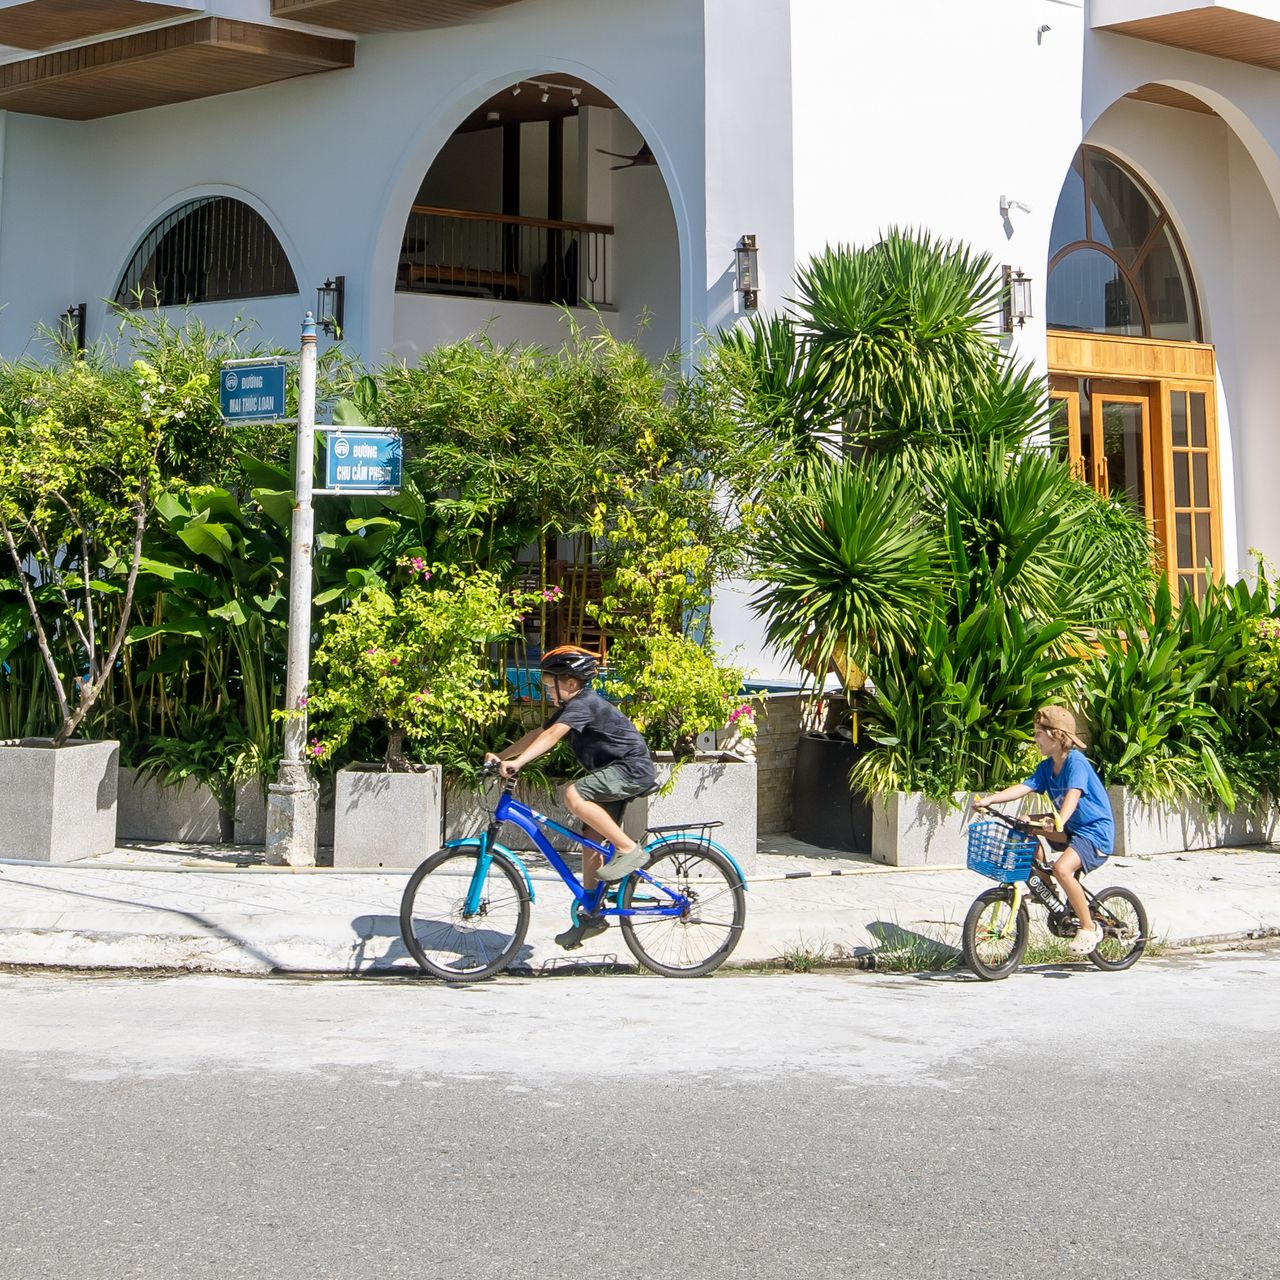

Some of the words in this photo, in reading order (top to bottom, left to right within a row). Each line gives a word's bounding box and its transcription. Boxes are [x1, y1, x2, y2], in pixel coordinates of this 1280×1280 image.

[229, 398, 241, 413] MAI
[258, 396, 274, 411] LOAN
[336, 465, 351, 481] CHU
